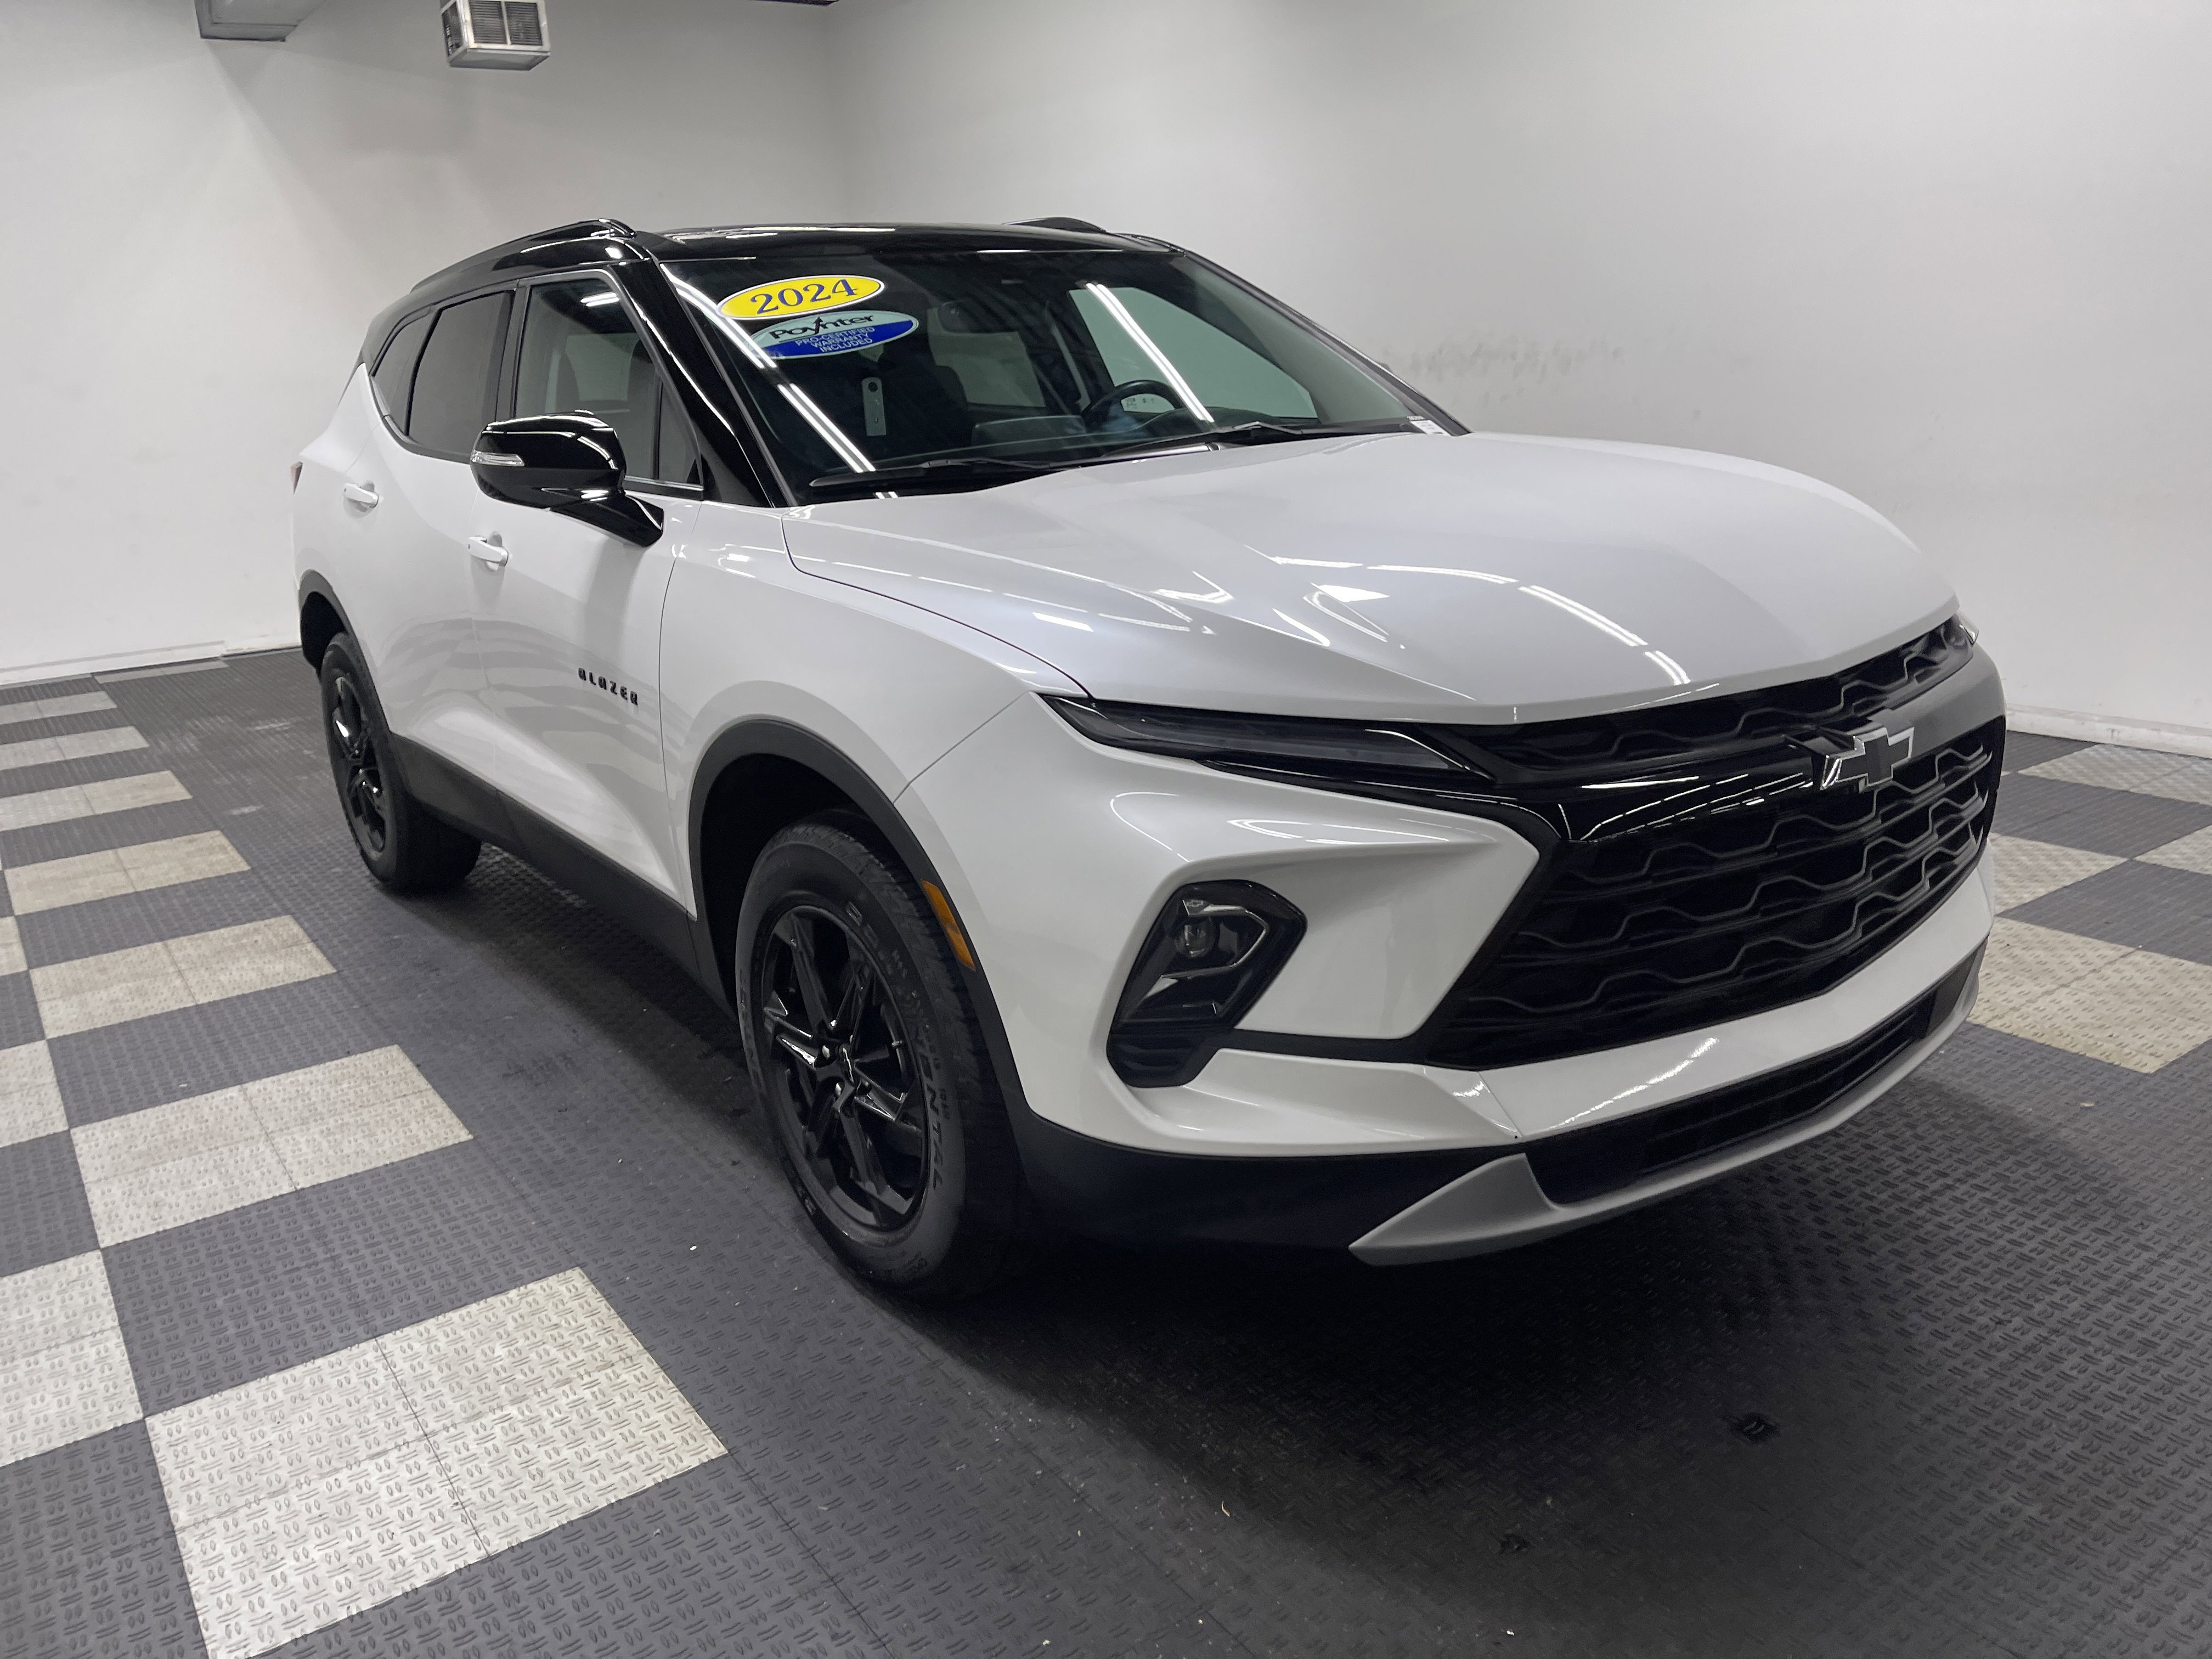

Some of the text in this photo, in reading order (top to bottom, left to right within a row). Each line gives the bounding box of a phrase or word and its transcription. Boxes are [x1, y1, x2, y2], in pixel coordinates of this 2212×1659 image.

[750, 279, 857, 314] 2024
[794, 326, 876, 346] PRO-CERTIFIED
[810, 332, 869, 348] WARRANTY
[819, 338, 873, 353] INCLUDED
[578, 668, 638, 706] BLAZER
